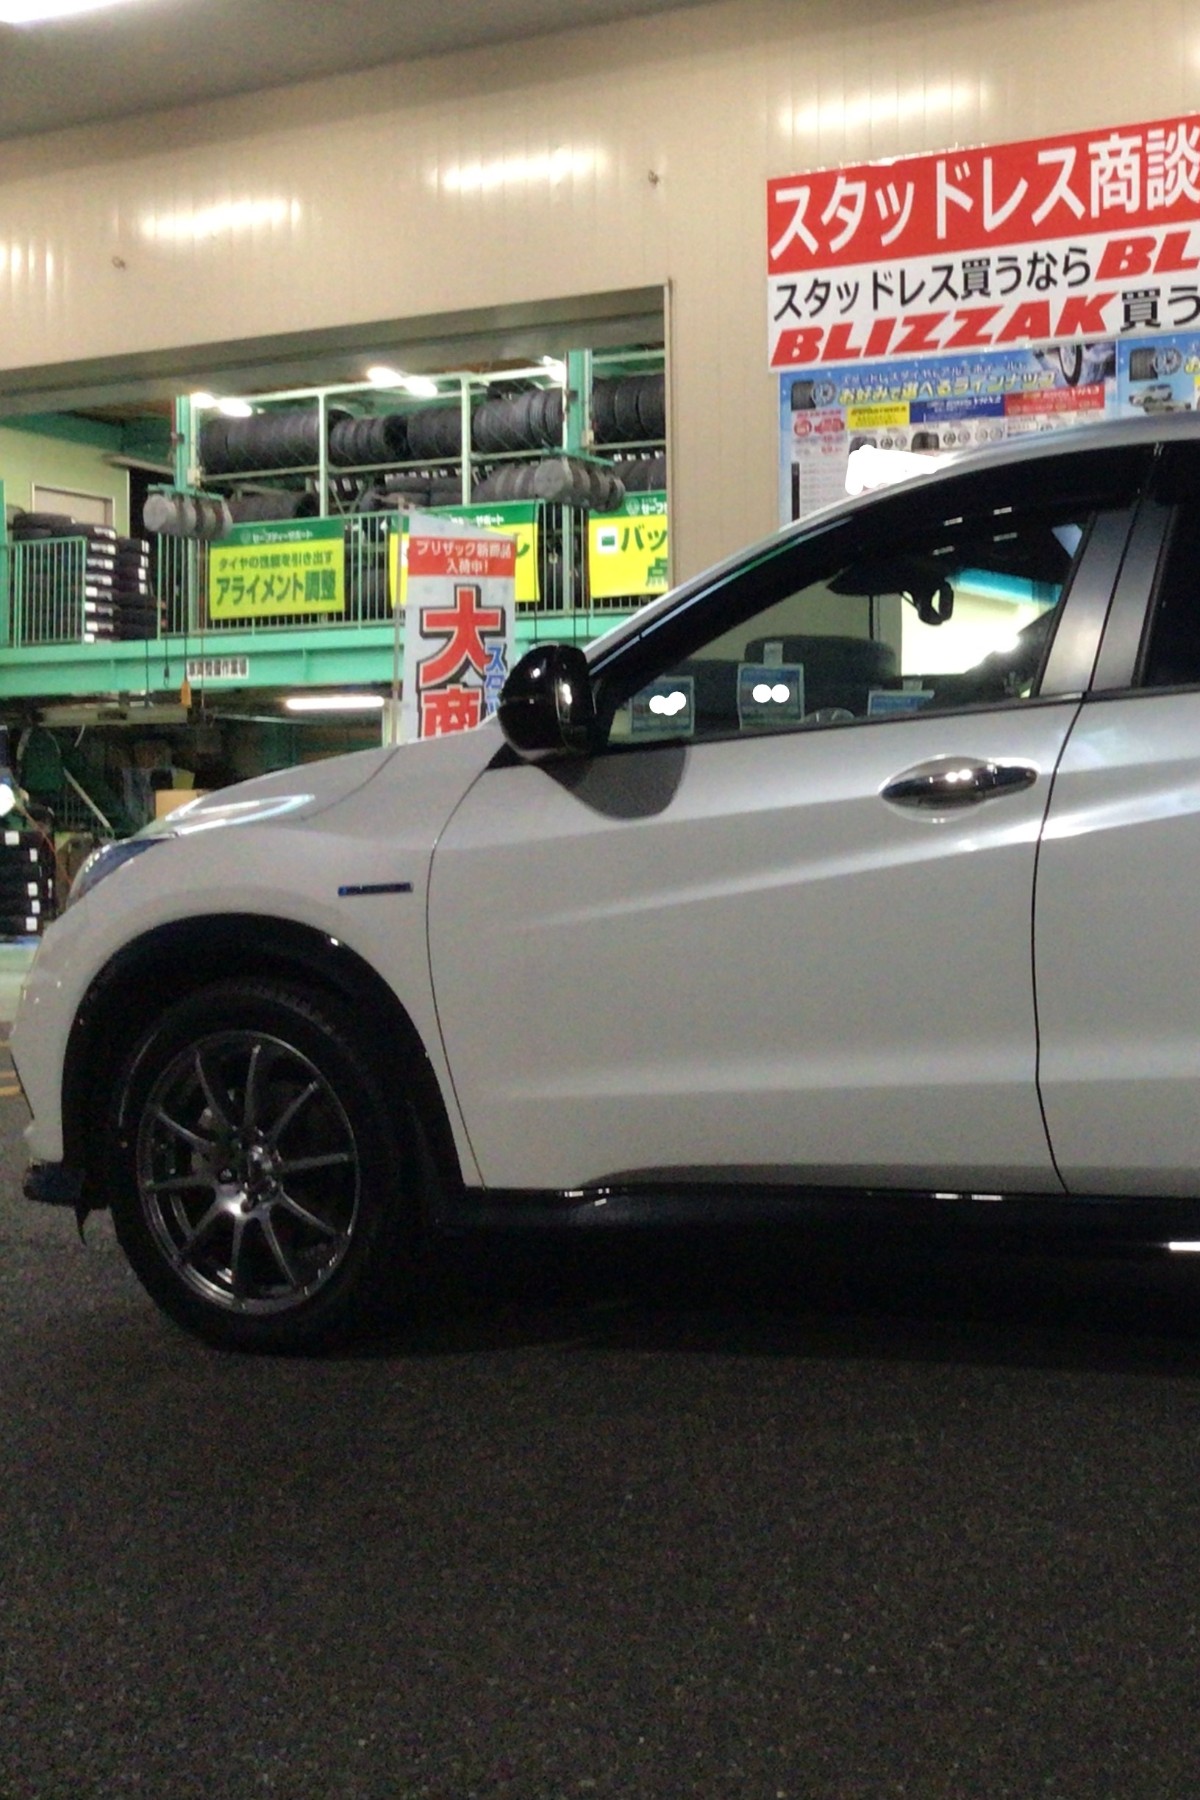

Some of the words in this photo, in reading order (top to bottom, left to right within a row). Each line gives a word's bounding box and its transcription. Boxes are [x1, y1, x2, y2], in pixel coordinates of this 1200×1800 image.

[774, 247, 1091, 321] スタッドレス買うなら
[770, 292, 1119, 366] BLIZZAK
[620, 523, 668, 552] バッ
[216, 568, 336, 606] アライメント調整
